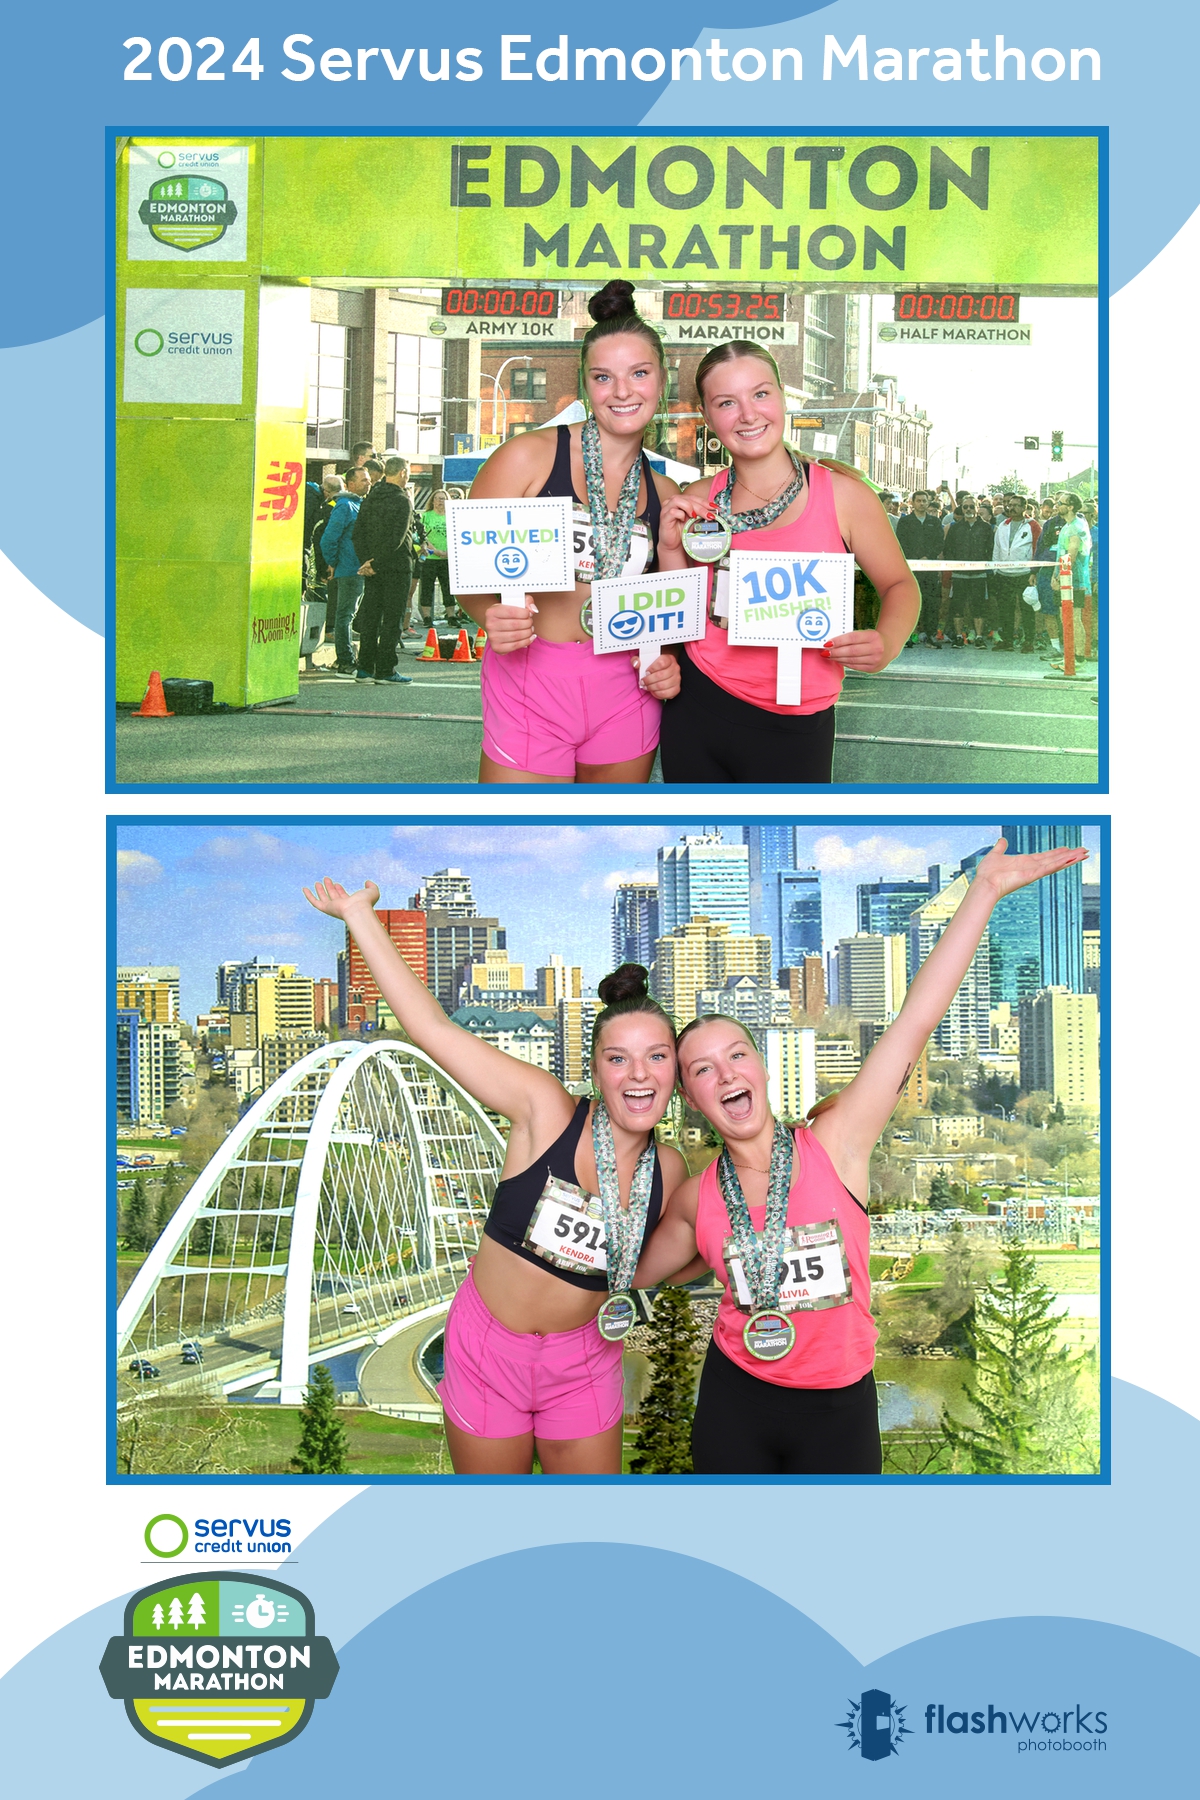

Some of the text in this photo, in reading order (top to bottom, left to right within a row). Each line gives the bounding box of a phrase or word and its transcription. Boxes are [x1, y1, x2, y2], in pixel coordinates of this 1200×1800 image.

[179, 152, 219, 161] servus
[450, 144, 990, 211] EDMONTON
[149, 203, 227, 213] EDMONTON
[160, 214, 215, 222] MARATHON
[523, 223, 907, 271] MARATHON
[465, 321, 554, 336] ARMY 10K
[678, 325, 785, 340] MARATHON
[900, 328, 939, 340] HALF
[943, 328, 1031, 340] MARATHON
[168, 332, 233, 345] servus
[167, 345, 233, 355] credit union
[506, 511, 512, 525] I
[461, 529, 559, 545] SURVIVED!
[742, 559, 827, 605] 10K
[618, 588, 686, 612] I DID
[743, 597, 832, 623] FINISHER!
[257, 613, 290, 634] Running
[648, 611, 684, 633] IT!
[559, 1245, 595, 1263] KENDRA
[556, 1258, 587, 1272] ARMY 10K
[780, 1256, 824, 1286] 915
